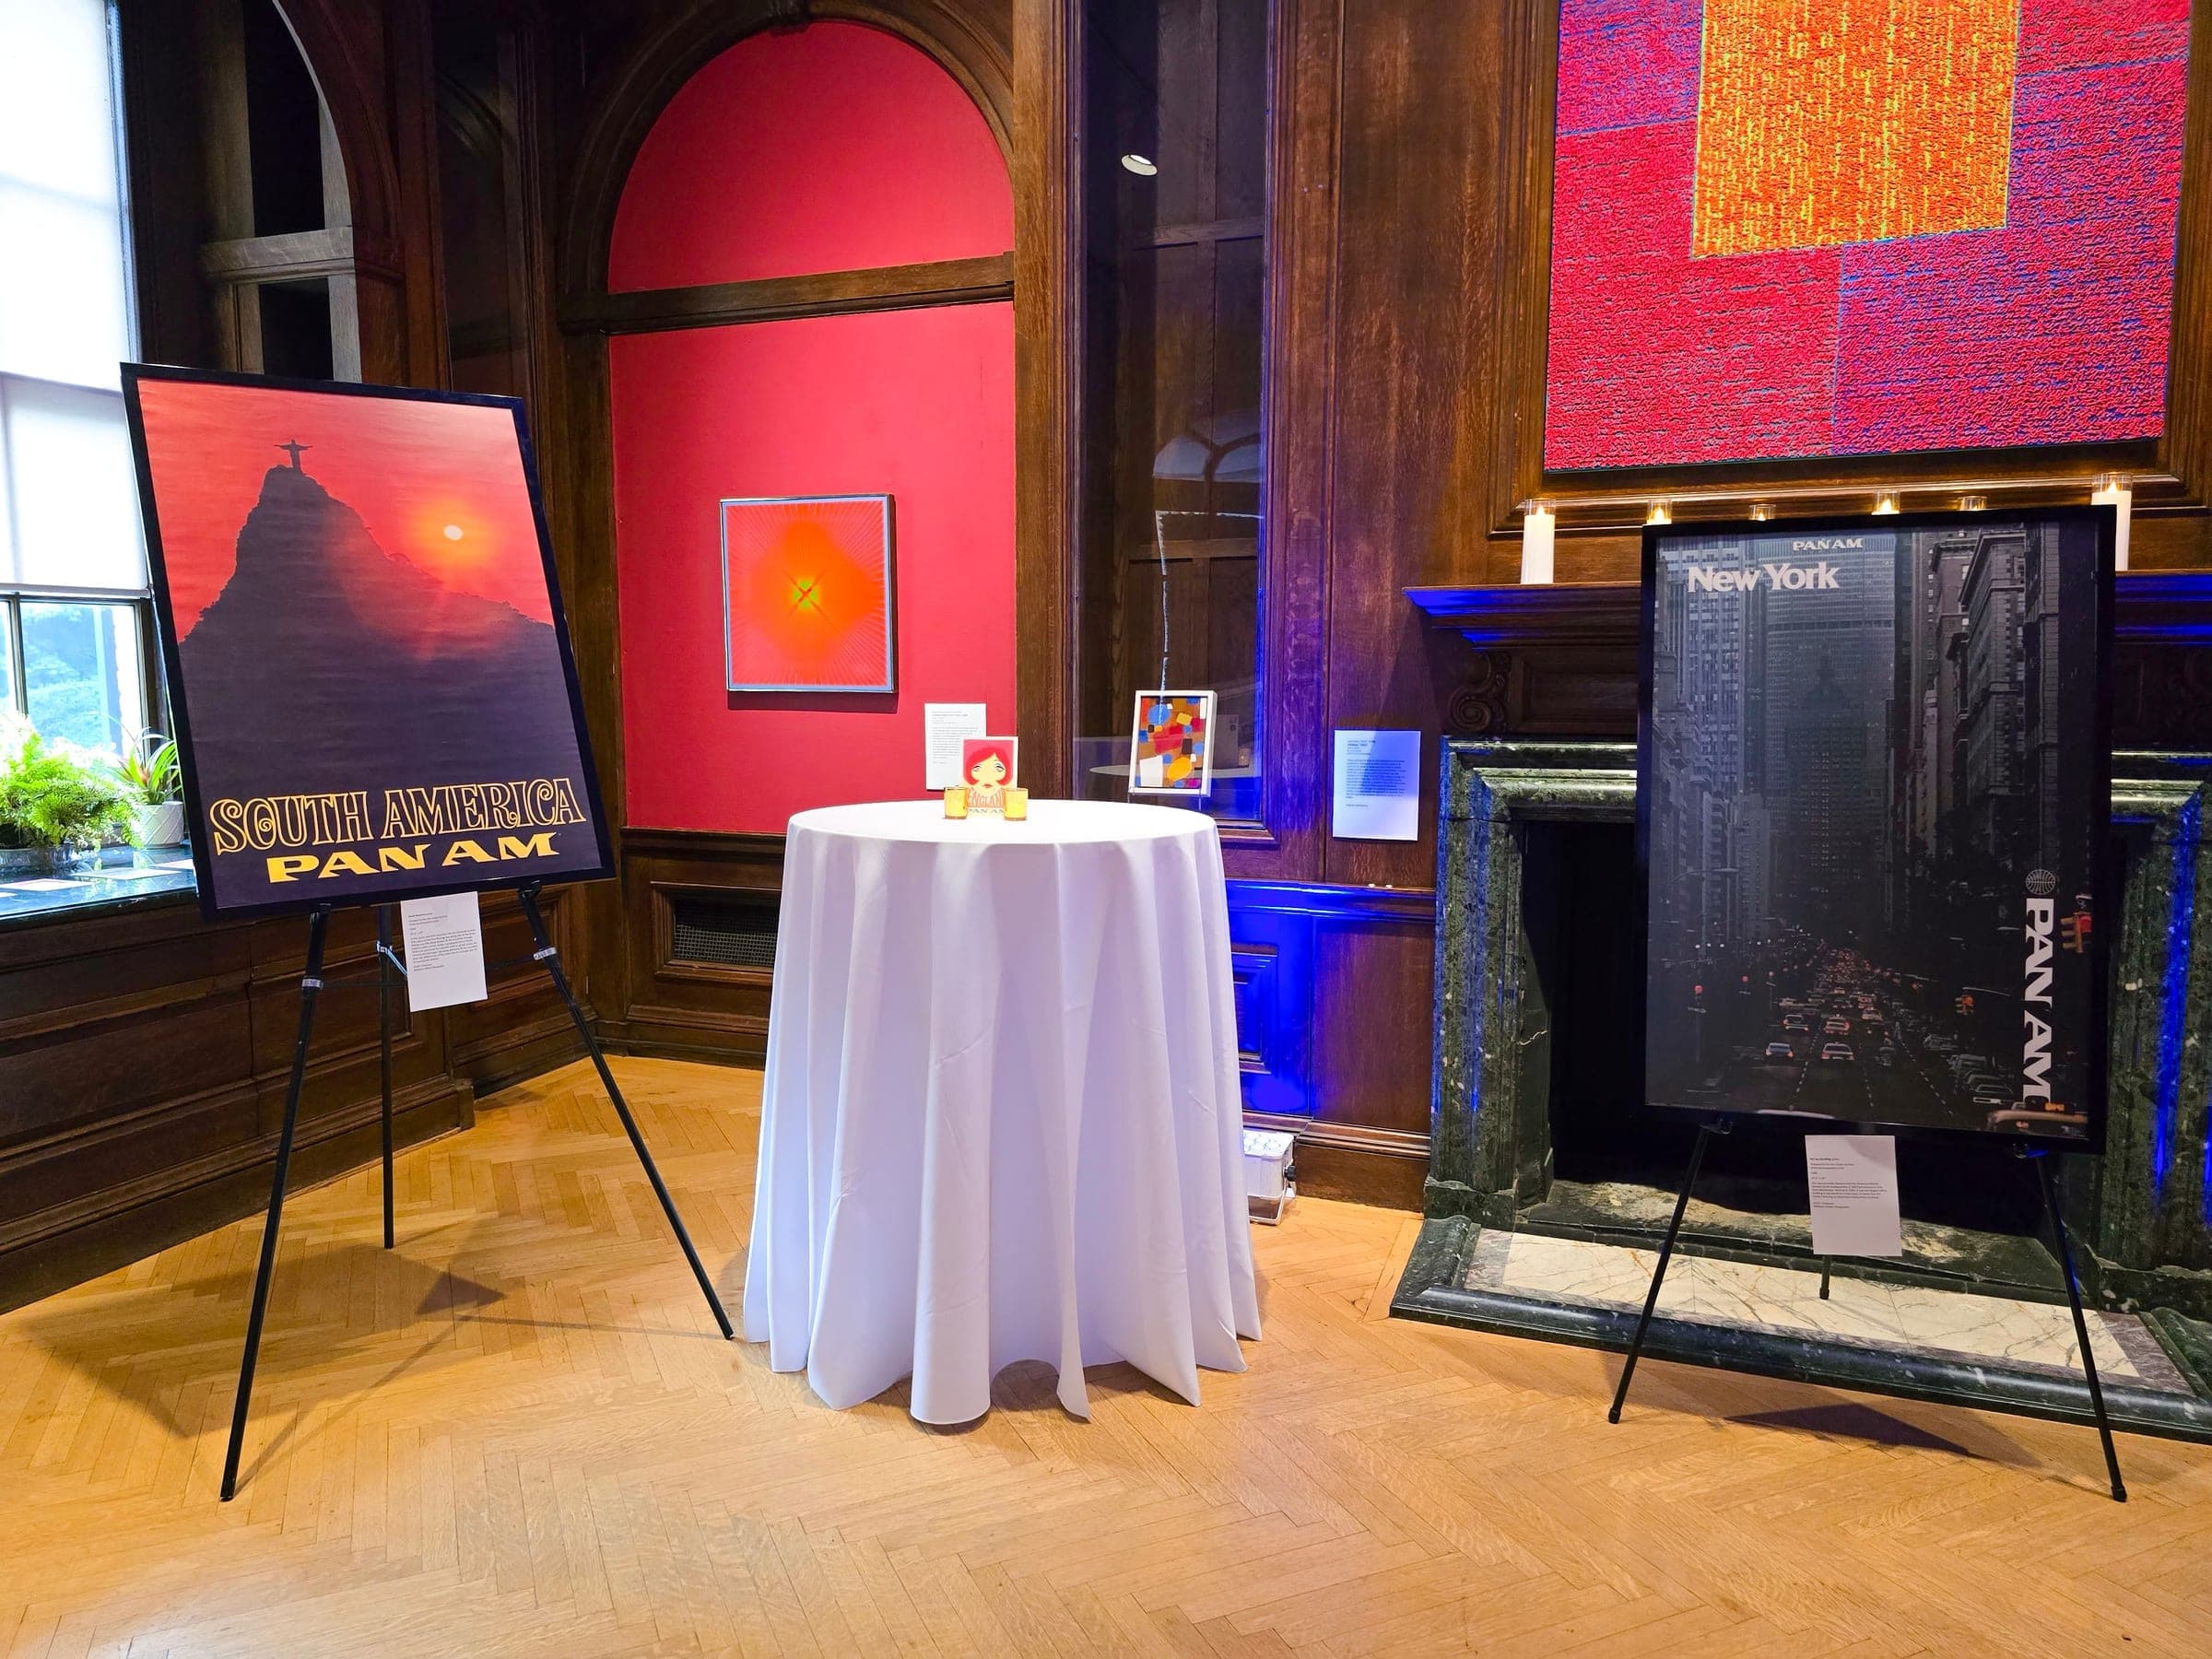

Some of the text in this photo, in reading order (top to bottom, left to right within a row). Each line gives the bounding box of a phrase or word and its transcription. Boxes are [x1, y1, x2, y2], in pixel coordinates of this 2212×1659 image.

[1793, 537, 1864, 551] PAN AM
[1687, 560, 1841, 593] New York
[209, 777, 587, 855] SOUTH AMERICA
[967, 789, 1004, 806] ENGLAN
[266, 831, 560, 883] PAN AM
[2023, 898, 2053, 1104] PAN AM
